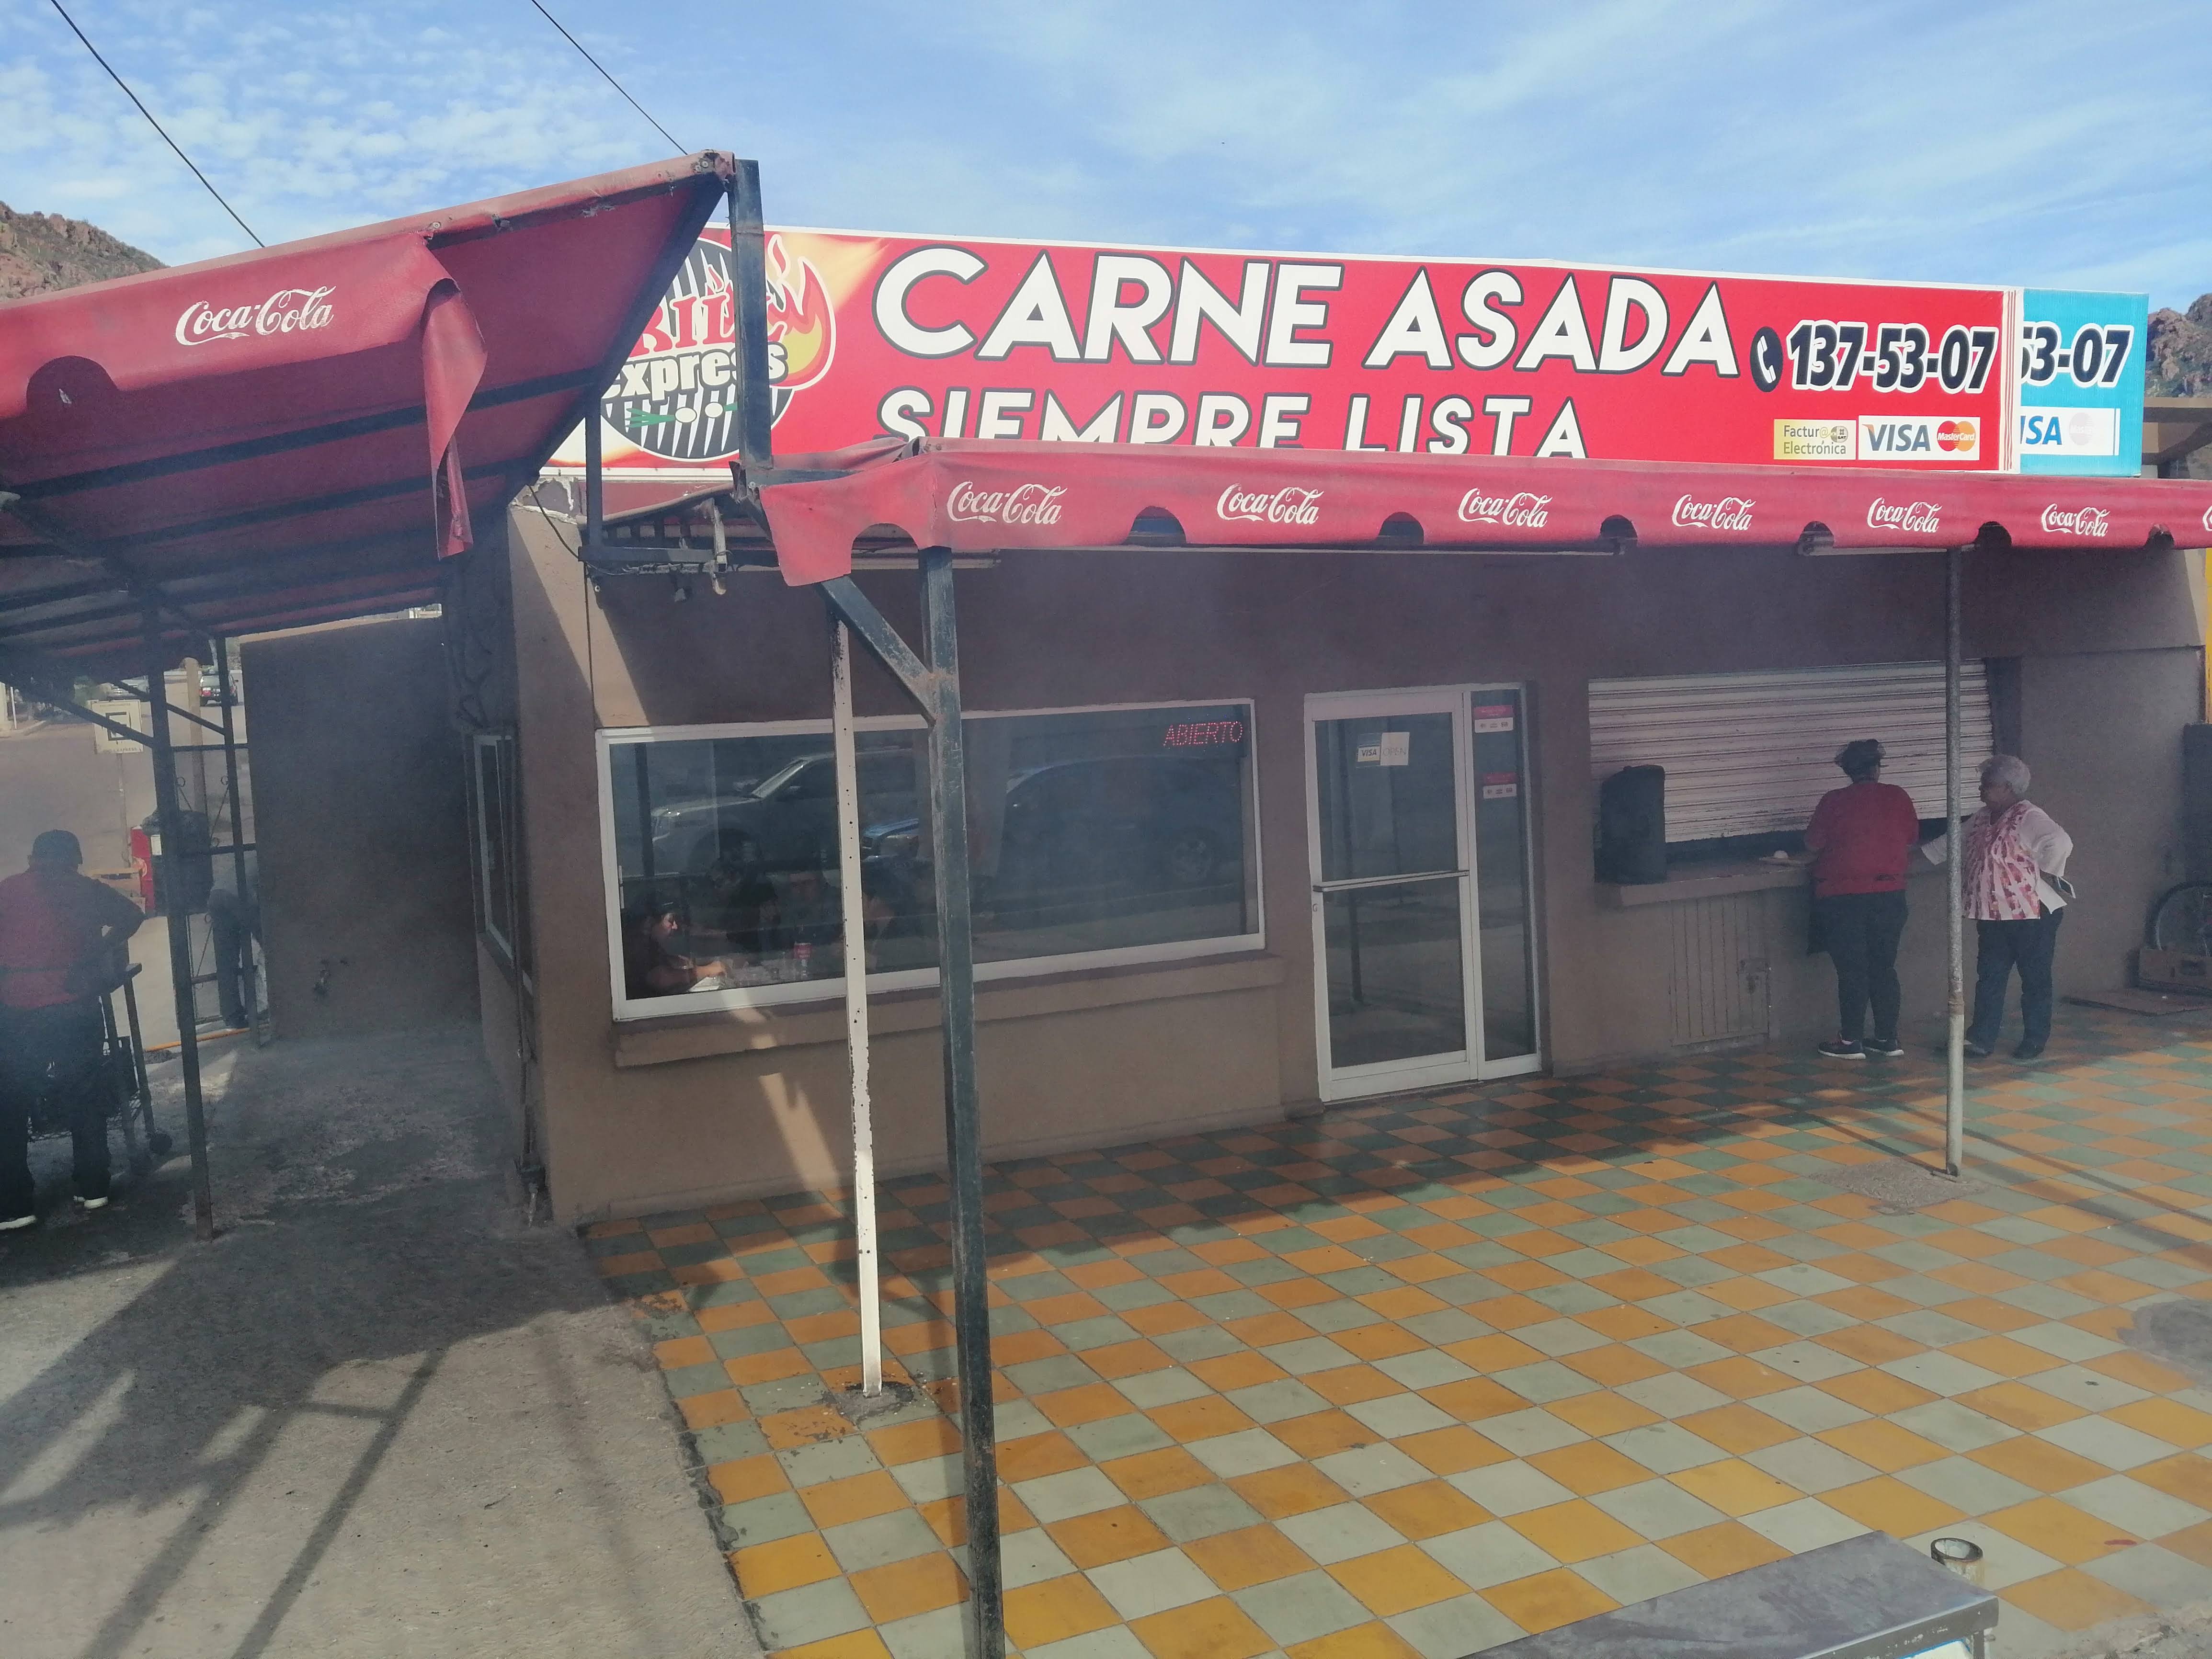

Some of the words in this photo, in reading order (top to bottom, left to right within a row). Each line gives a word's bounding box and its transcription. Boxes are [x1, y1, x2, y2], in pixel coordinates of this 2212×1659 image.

[176, 286, 336, 346] Coca-Cola
[872, 244, 1344, 368] CARNE
[1362, 265, 1741, 377] ASADA
[602, 342, 788, 401] xpres
[1787, 319, 1999, 394] 137-53-07
[873, 386, 1311, 448] SIEMPRE
[1342, 393, 1589, 459] LISTA
[1862, 424, 1931, 452] VISA
[1937, 432, 1976, 441] MasterCard
[1784, 440, 1847, 455] Electrónica
[946, 480, 1068, 524] Coca-Cola
[1217, 483, 1324, 524] Coca-Cola
[1458, 488, 1553, 528] Coca-Cola
[1672, 493, 1756, 531] Coca-Cola
[1867, 497, 1942, 533] Coca-Cola
[2041, 503, 2110, 537] Coca-Cola
[1163, 720, 1244, 746] ABIERTO
